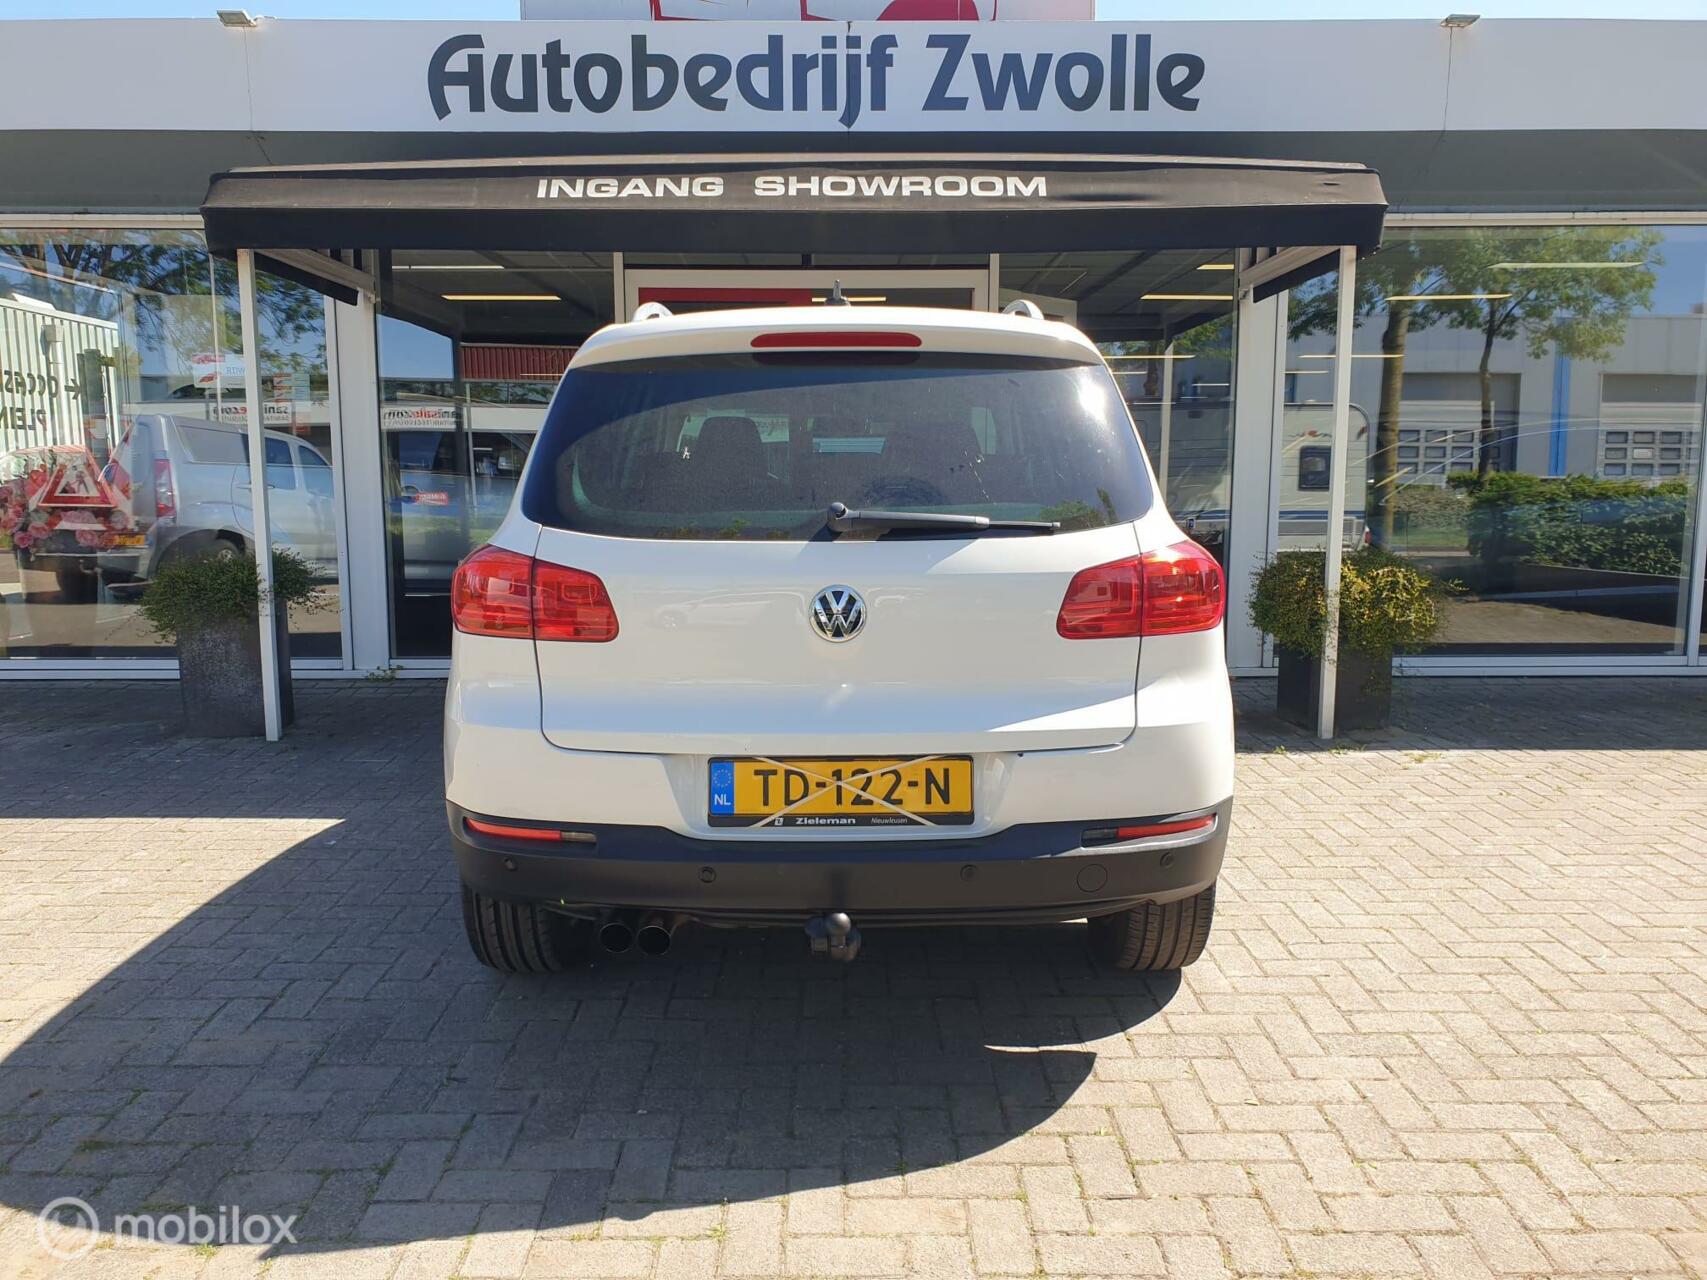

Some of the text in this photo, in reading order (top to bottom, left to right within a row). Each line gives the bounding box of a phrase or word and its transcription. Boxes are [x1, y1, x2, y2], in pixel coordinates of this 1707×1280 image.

[427, 33, 1206, 129] Autobedrijf Zwolle
[536, 176, 1048, 199] INGANG SHOWROOM
[753, 767, 951, 807] TD-122-N
[713, 793, 732, 806] NL
[795, 816, 857, 825] Zieleman
